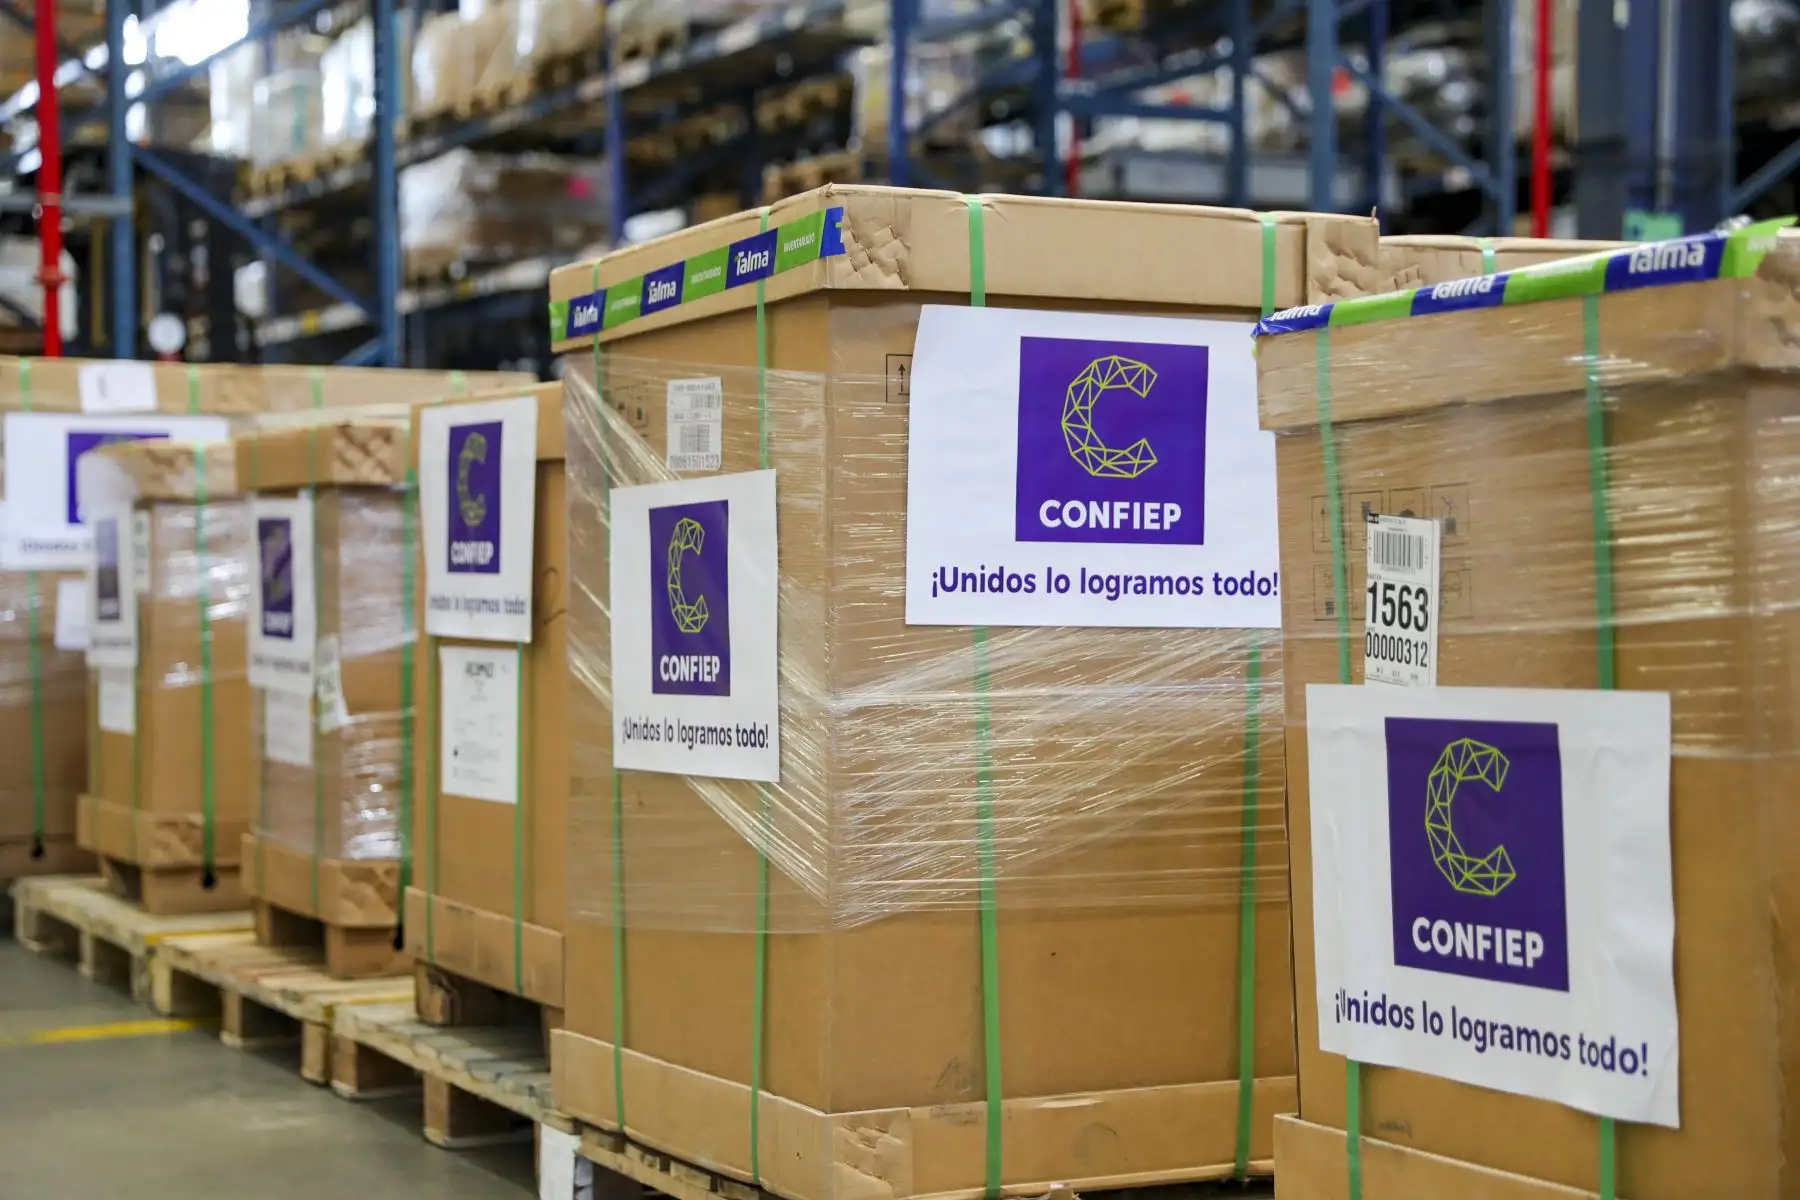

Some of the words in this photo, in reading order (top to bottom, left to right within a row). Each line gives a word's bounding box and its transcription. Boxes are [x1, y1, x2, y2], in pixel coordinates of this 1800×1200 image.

[648, 280, 677, 305] Talma
[735, 249, 770, 277] Talma
[783, 232, 815, 253] INVENTARIADO
[1038, 499, 1182, 531] CONFIEP
[932, 565, 1036, 598] ¡Unidos
[1046, 566, 1070, 595] lo
[1080, 567, 1204, 601] logramos
[1212, 570, 1279, 597] todo!
[1367, 581, 1429, 632] 1563
[1366, 632, 1428, 668] 00000312
[660, 655, 721, 682] CONFIEP
[622, 716, 661, 744] ¡Unidos
[664, 718, 674, 743] lo
[677, 718, 733, 750] logramos
[736, 721, 769, 749] todo!
[1411, 916, 1545, 969] CONFIEP
[1335, 988, 1415, 1031] ¡Unidos
[1422, 1000, 1444, 1037] lo
[1451, 1005, 1571, 1060] logramos
[1578, 1033, 1649, 1077] todo!
